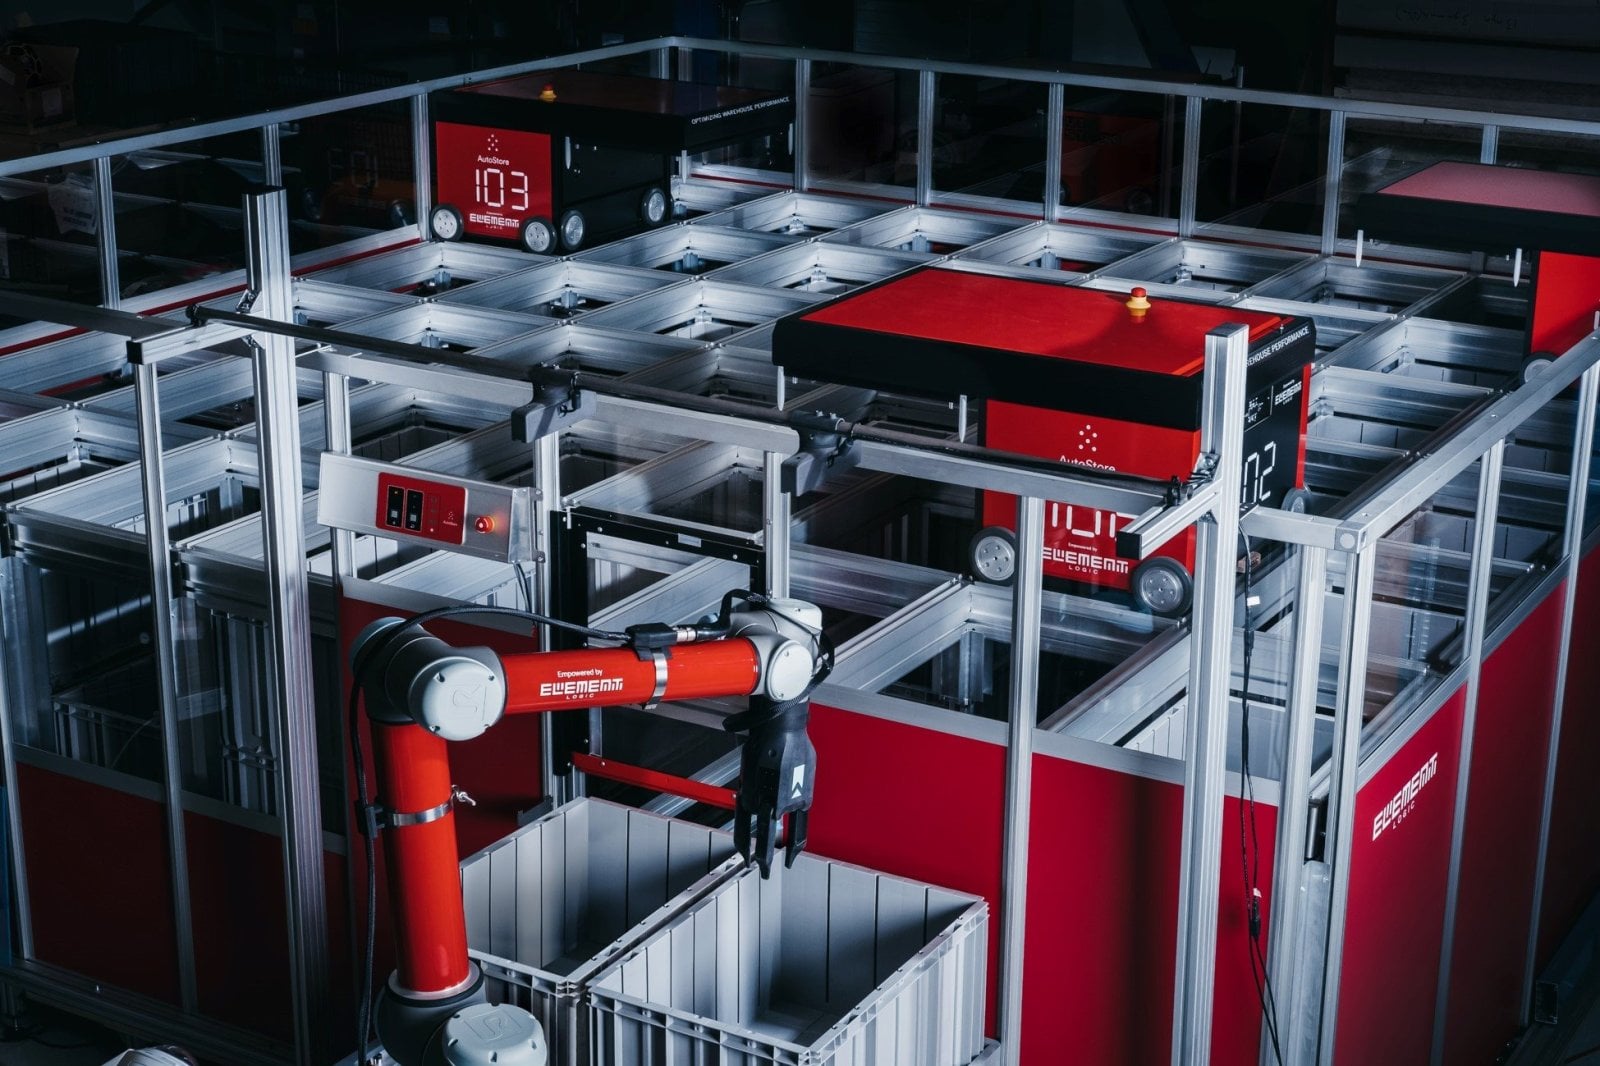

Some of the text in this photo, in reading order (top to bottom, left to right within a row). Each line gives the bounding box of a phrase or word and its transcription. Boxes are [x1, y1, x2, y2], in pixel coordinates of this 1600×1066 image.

[691, 96, 790, 125] OPTIMIZING WAREHOUSE PERFORMANCE
[477, 155, 510, 166] AutoStore
[475, 168, 529, 211] 103
[469, 213, 520, 228] ELEMENT
[1246, 325, 1310, 366] REHOUSE PERFORMANCE
[1242, 440, 1277, 504] 02
[1043, 546, 1129, 574] ELEMENT
[1068, 565, 1099, 575] LOGIC
[540, 677, 624, 697] ELEMENT
[557, 668, 603, 679] Empowered by
[1372, 752, 1439, 842] ELEMENT
[1392, 800, 1416, 830] LOGIC
